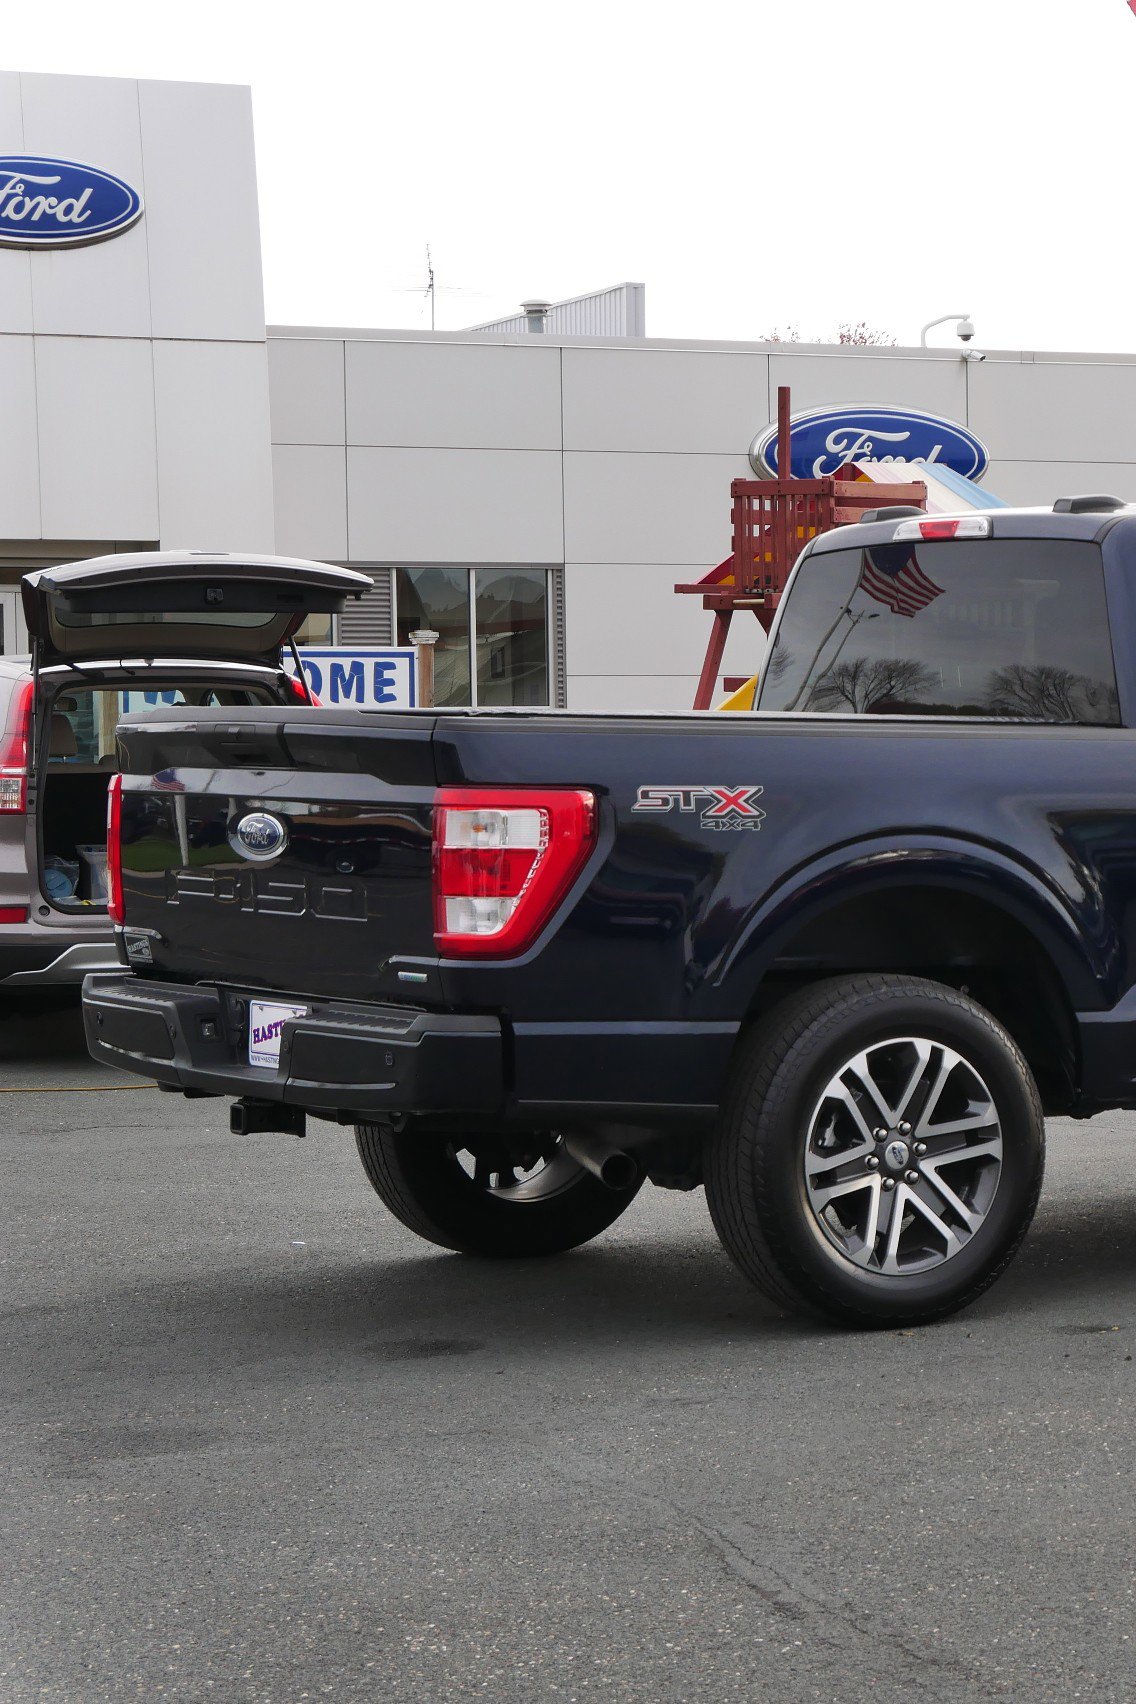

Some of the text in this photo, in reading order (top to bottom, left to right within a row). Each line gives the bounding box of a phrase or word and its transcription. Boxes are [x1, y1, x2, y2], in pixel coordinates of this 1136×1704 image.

[0, 171, 93, 223] Ford
[631, 785, 766, 820] STX
[244, 821, 270, 845] Ford
